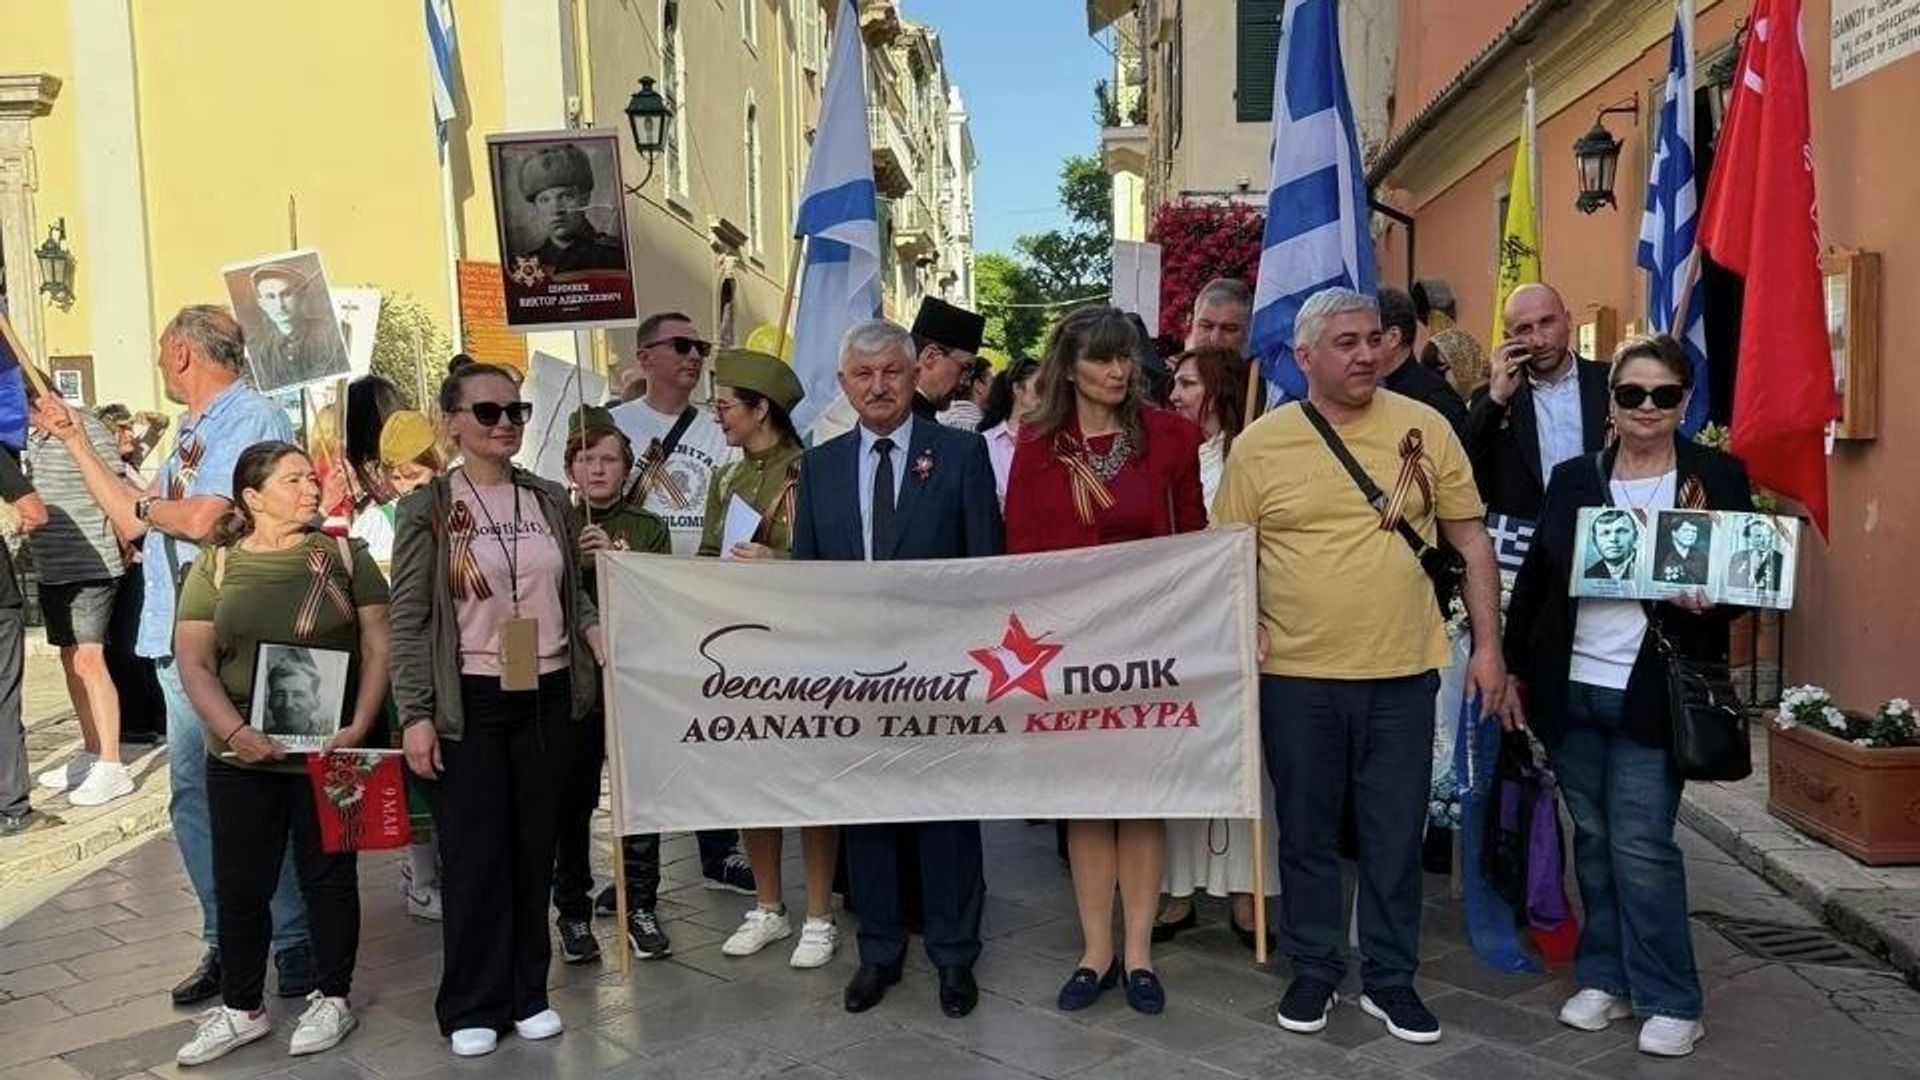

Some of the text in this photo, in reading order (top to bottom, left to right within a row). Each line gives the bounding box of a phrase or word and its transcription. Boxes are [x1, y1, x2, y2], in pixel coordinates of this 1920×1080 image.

[1063, 658, 1179, 695] ПОЛК
[681, 701, 1200, 743] ΑΘΑΝΑΤΟ ΤΑΓΜΑ ΚΕΡΚΥΡΑ
[383, 787, 399, 836] 9 МАЯ
